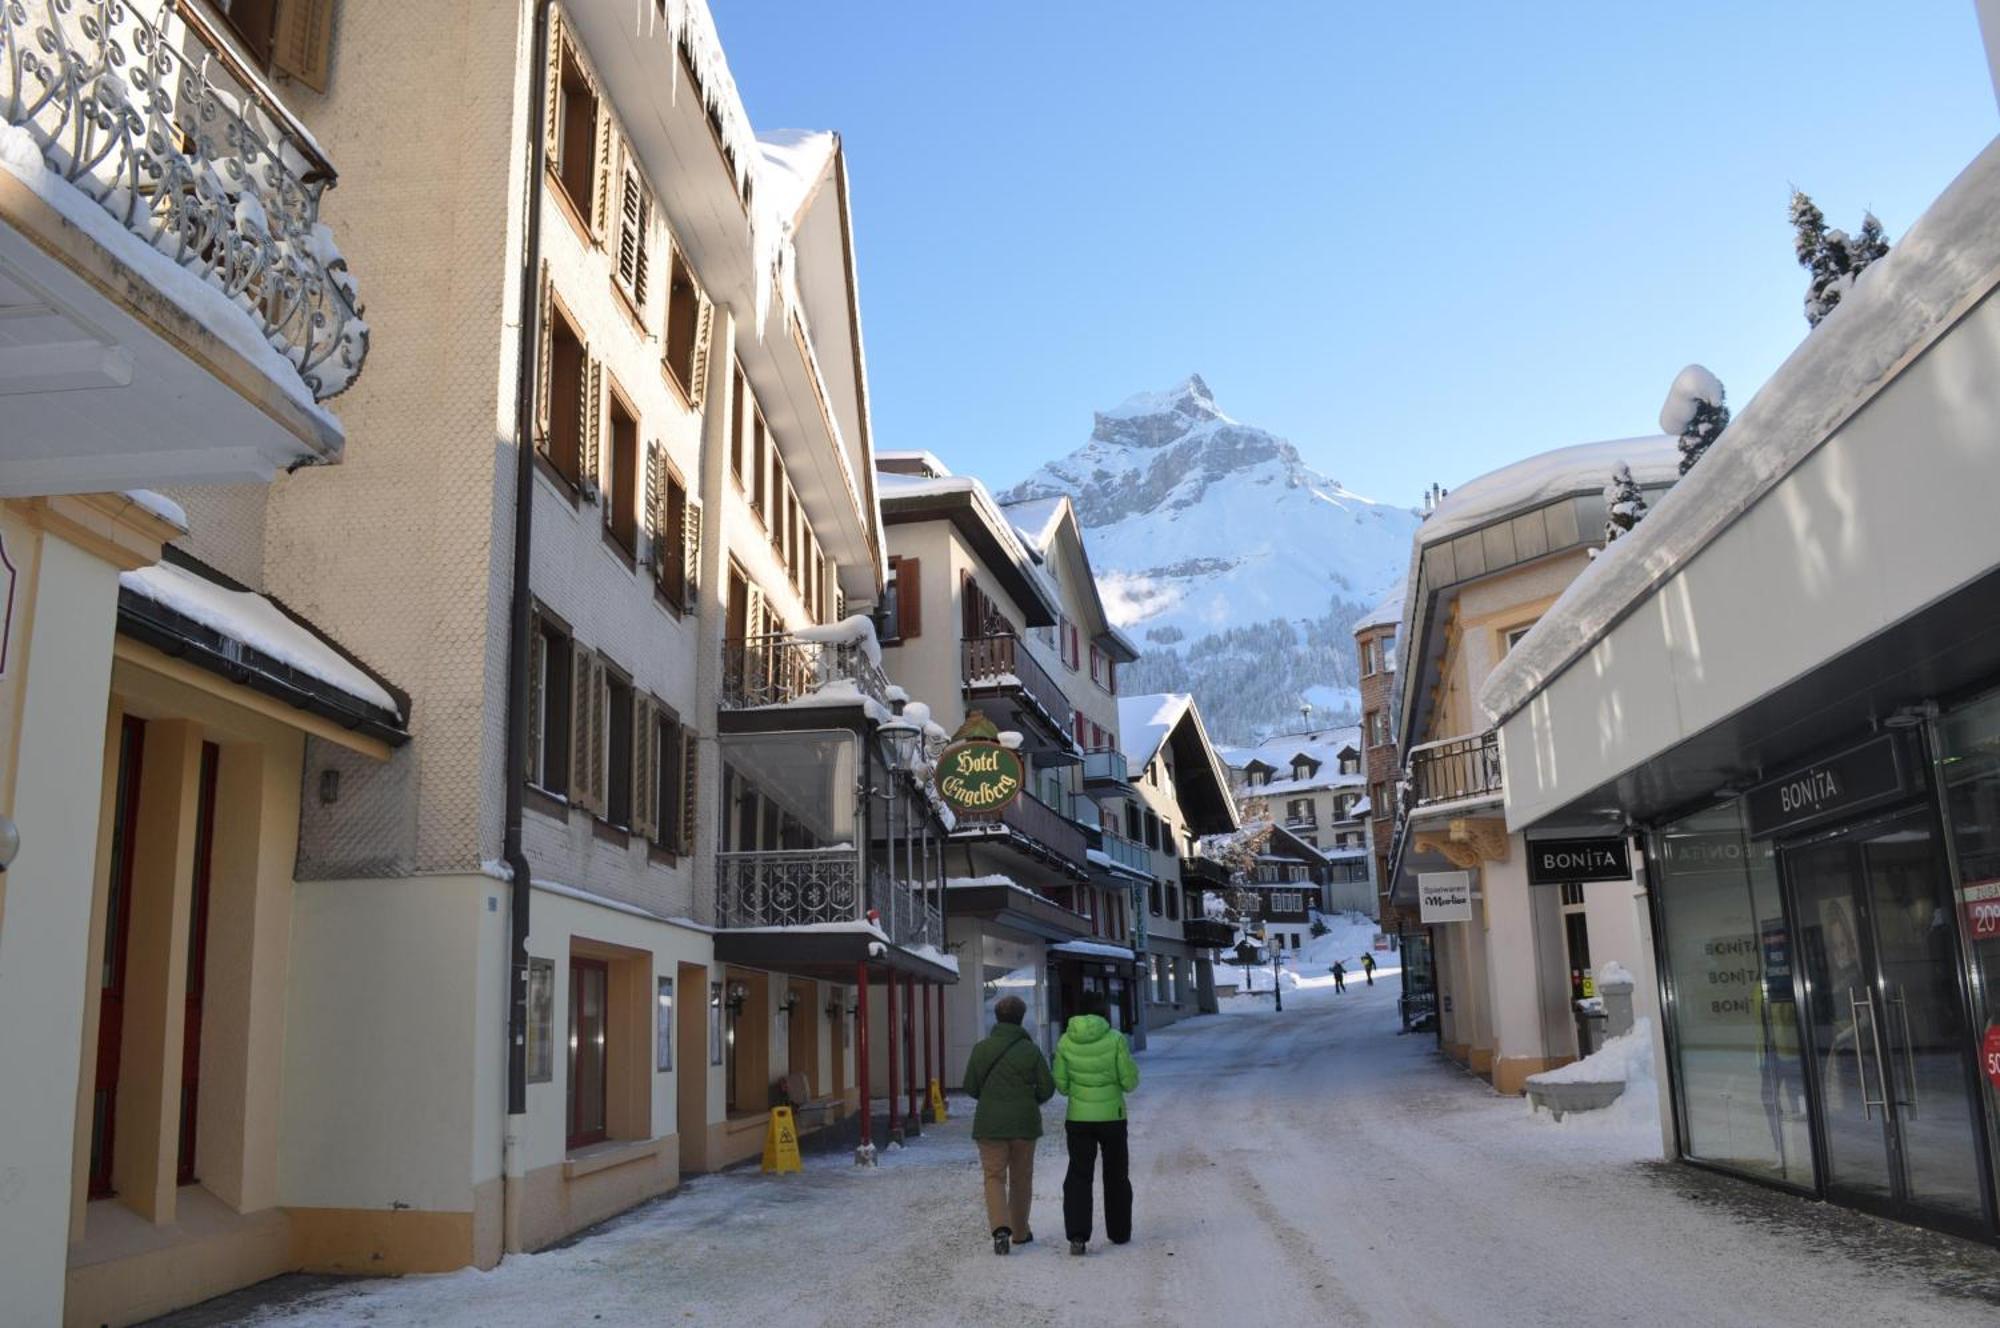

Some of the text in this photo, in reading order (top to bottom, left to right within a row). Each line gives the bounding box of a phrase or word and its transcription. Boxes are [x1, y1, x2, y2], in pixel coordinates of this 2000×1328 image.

[957, 749, 999, 775] Hotel
[942, 775, 1017, 807] Engelberg
[1781, 769, 1837, 812] BONITA
[1544, 848, 1616, 871] BONITA
